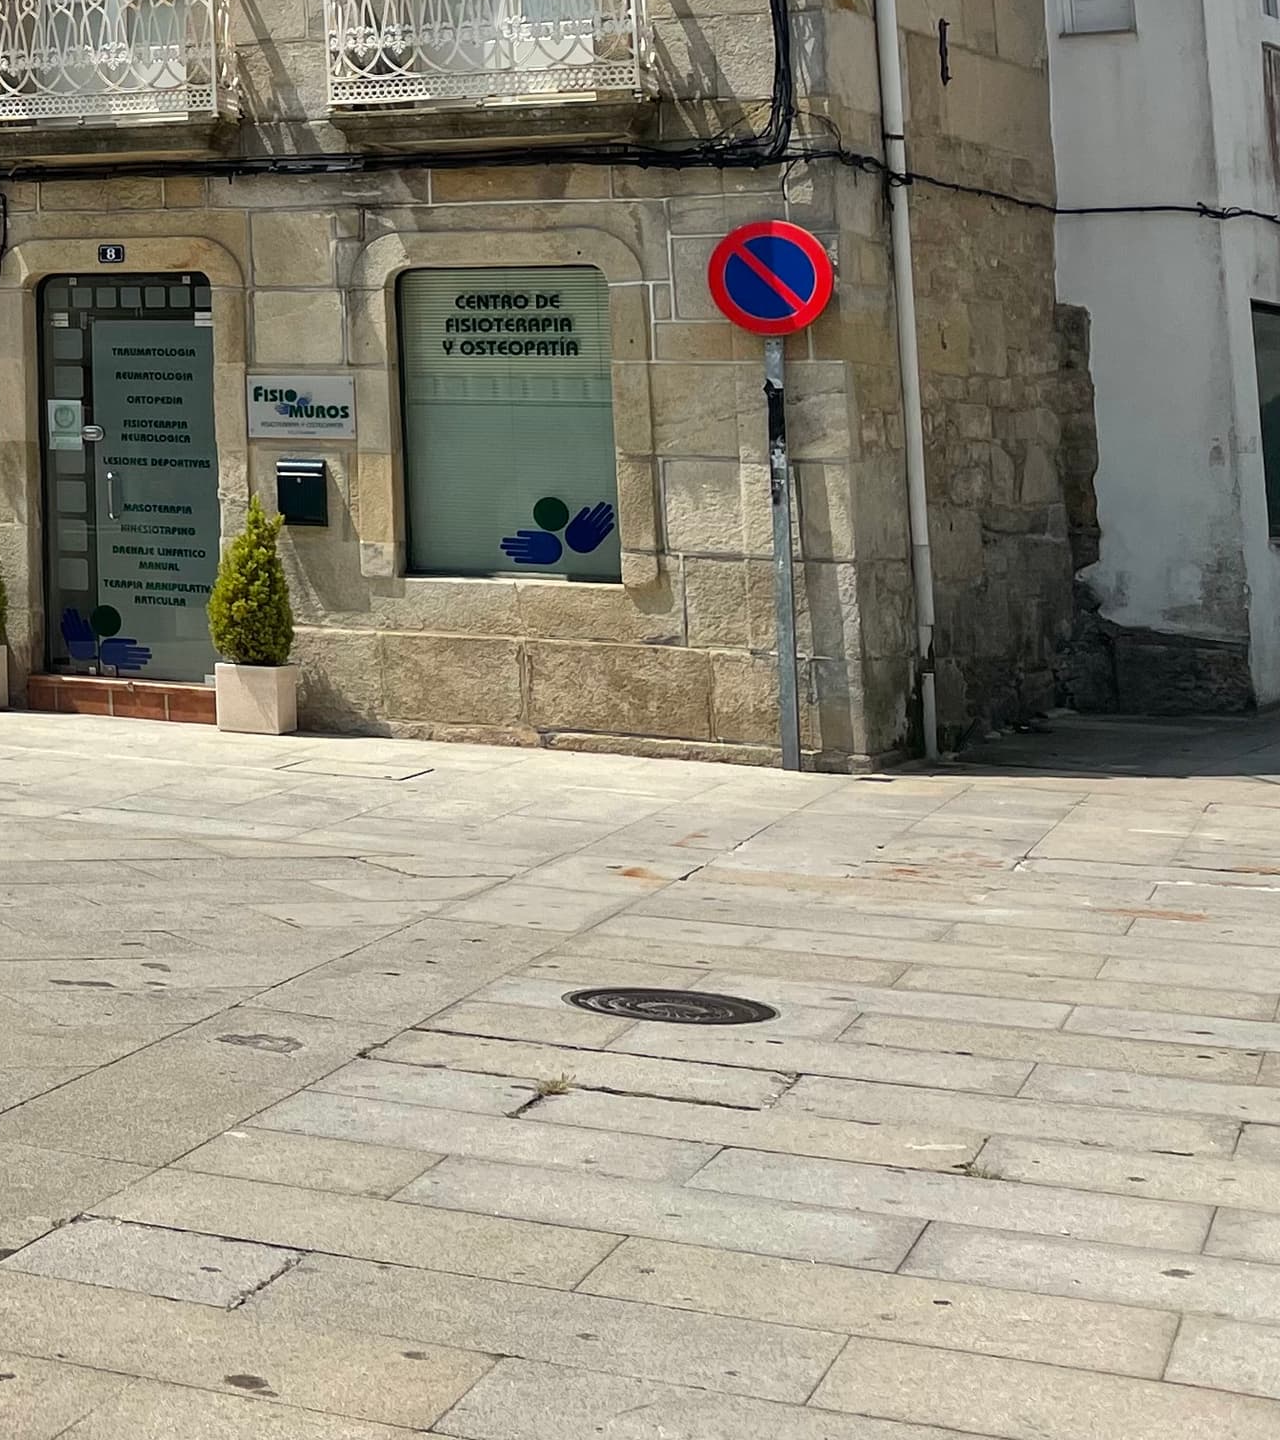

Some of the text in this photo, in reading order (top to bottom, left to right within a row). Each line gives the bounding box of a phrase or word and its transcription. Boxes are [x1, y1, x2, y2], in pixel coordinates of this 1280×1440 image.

[107, 247, 116, 260] 8
[455, 294, 560, 309] CENTRO DE
[445, 317, 572, 333] FISIOTERAPIA
[442, 336, 579, 356] Y OSTEOPATÍA
[112, 347, 196, 357] TRAUMATOLOGIA
[115, 371, 193, 381] REUMATOLOGIA
[126, 395, 183, 405] ORTOPEDIA
[288, 405, 350, 418] MUROS
[123, 419, 188, 429] FISIOTERAPIA
[121, 433, 191, 443] NEUROLOGICA
[103, 456, 211, 468] LESIONES DEPORTIVAS
[123, 503, 193, 515] MASOTERAPIA
[112, 545, 206, 559] DRENAJE LINFATICO
[139, 561, 180, 572] MANUAL
[104, 579, 143, 589] TERAPIA
[134, 596, 186, 607] ARTICULAR
